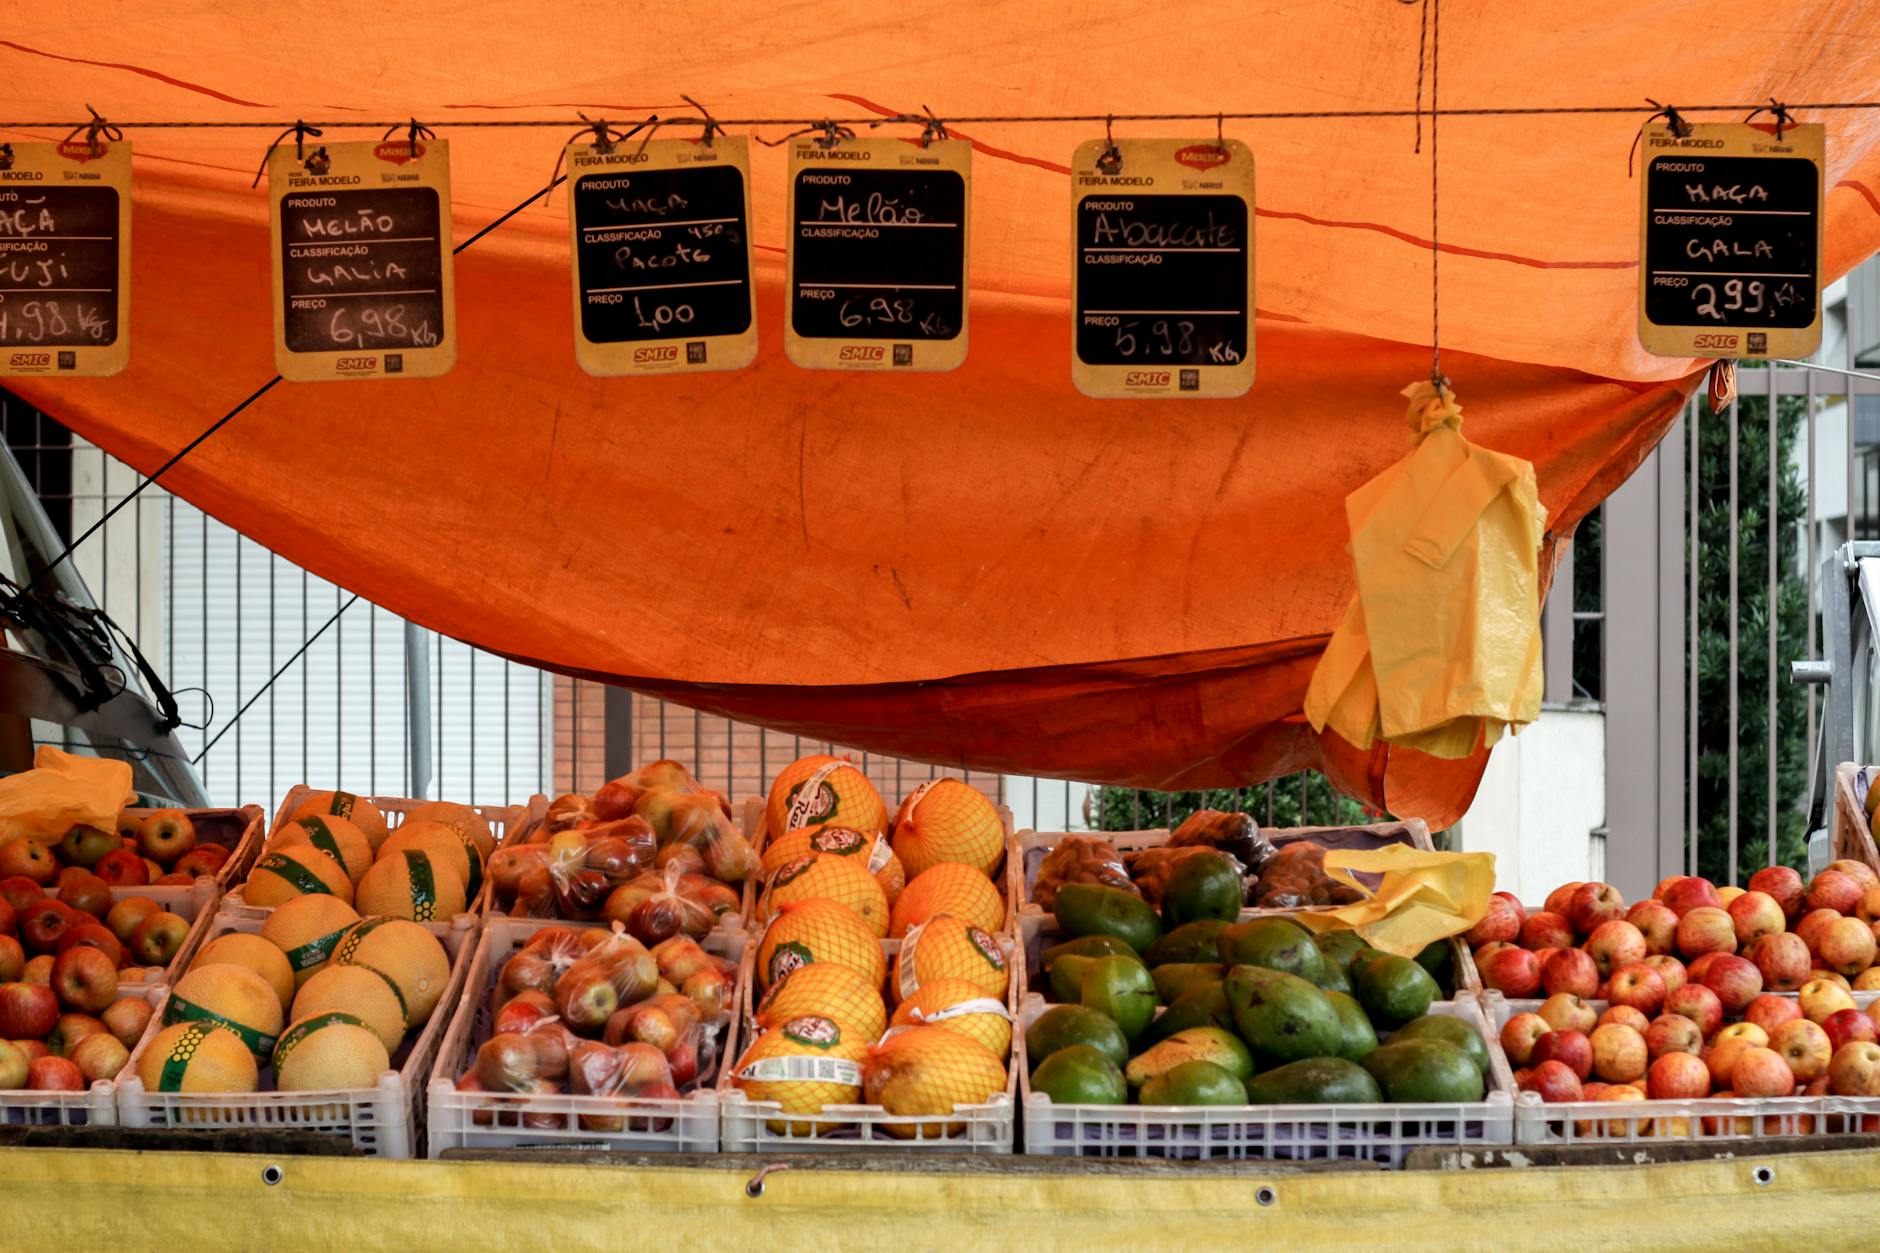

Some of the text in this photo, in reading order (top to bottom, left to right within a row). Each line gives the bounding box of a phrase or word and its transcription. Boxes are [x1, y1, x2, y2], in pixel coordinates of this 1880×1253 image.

[1649, 138, 1724, 149] FEIRA MODELO
[574, 156, 604, 167] FEIRA
[796, 150, 871, 161] FEIRA MODELO
[1656, 162, 1705, 173] PRODUTO
[2, 171, 43, 181] MODELO
[288, 175, 361, 187] FEIRA MODELO
[802, 175, 851, 185] PRODUTO
[1079, 176, 1154, 186] FEIRA MODELO
[581, 179, 630, 191] PRODUTO
[288, 197, 337, 208] PRODUTO
[818, 192, 925, 224] Melão
[1085, 201, 1134, 211] PRODUTO
[1654, 215, 1733, 227] CLASSIFICAÇÃO
[584, 229, 662, 244] CLASSIFICAÇÃO
[801, 228, 880, 240] CLASSIFICAÇÃO
[290, 245, 369, 258] CLASSIFICAÇÃO
[1686, 238, 1773, 263] GALA
[1084, 254, 1163, 266] CLASSIFICAÇÃO
[1653, 277, 1689, 288] PREÇO
[588, 293, 624, 305] PREÇO
[800, 289, 835, 301] PREÇO
[291, 299, 327, 310] PREÇO
[330, 304, 408, 349] 6,98
[1084, 316, 1120, 327] PREÇO
[1693, 333, 1739, 348] SMIC
[633, 346, 679, 363] SMIC
[839, 345, 885, 361] SMIC
[10, 353, 51, 366] SMIC
[336, 357, 377, 370] SMIC
[1125, 371, 1172, 386] SMIC
